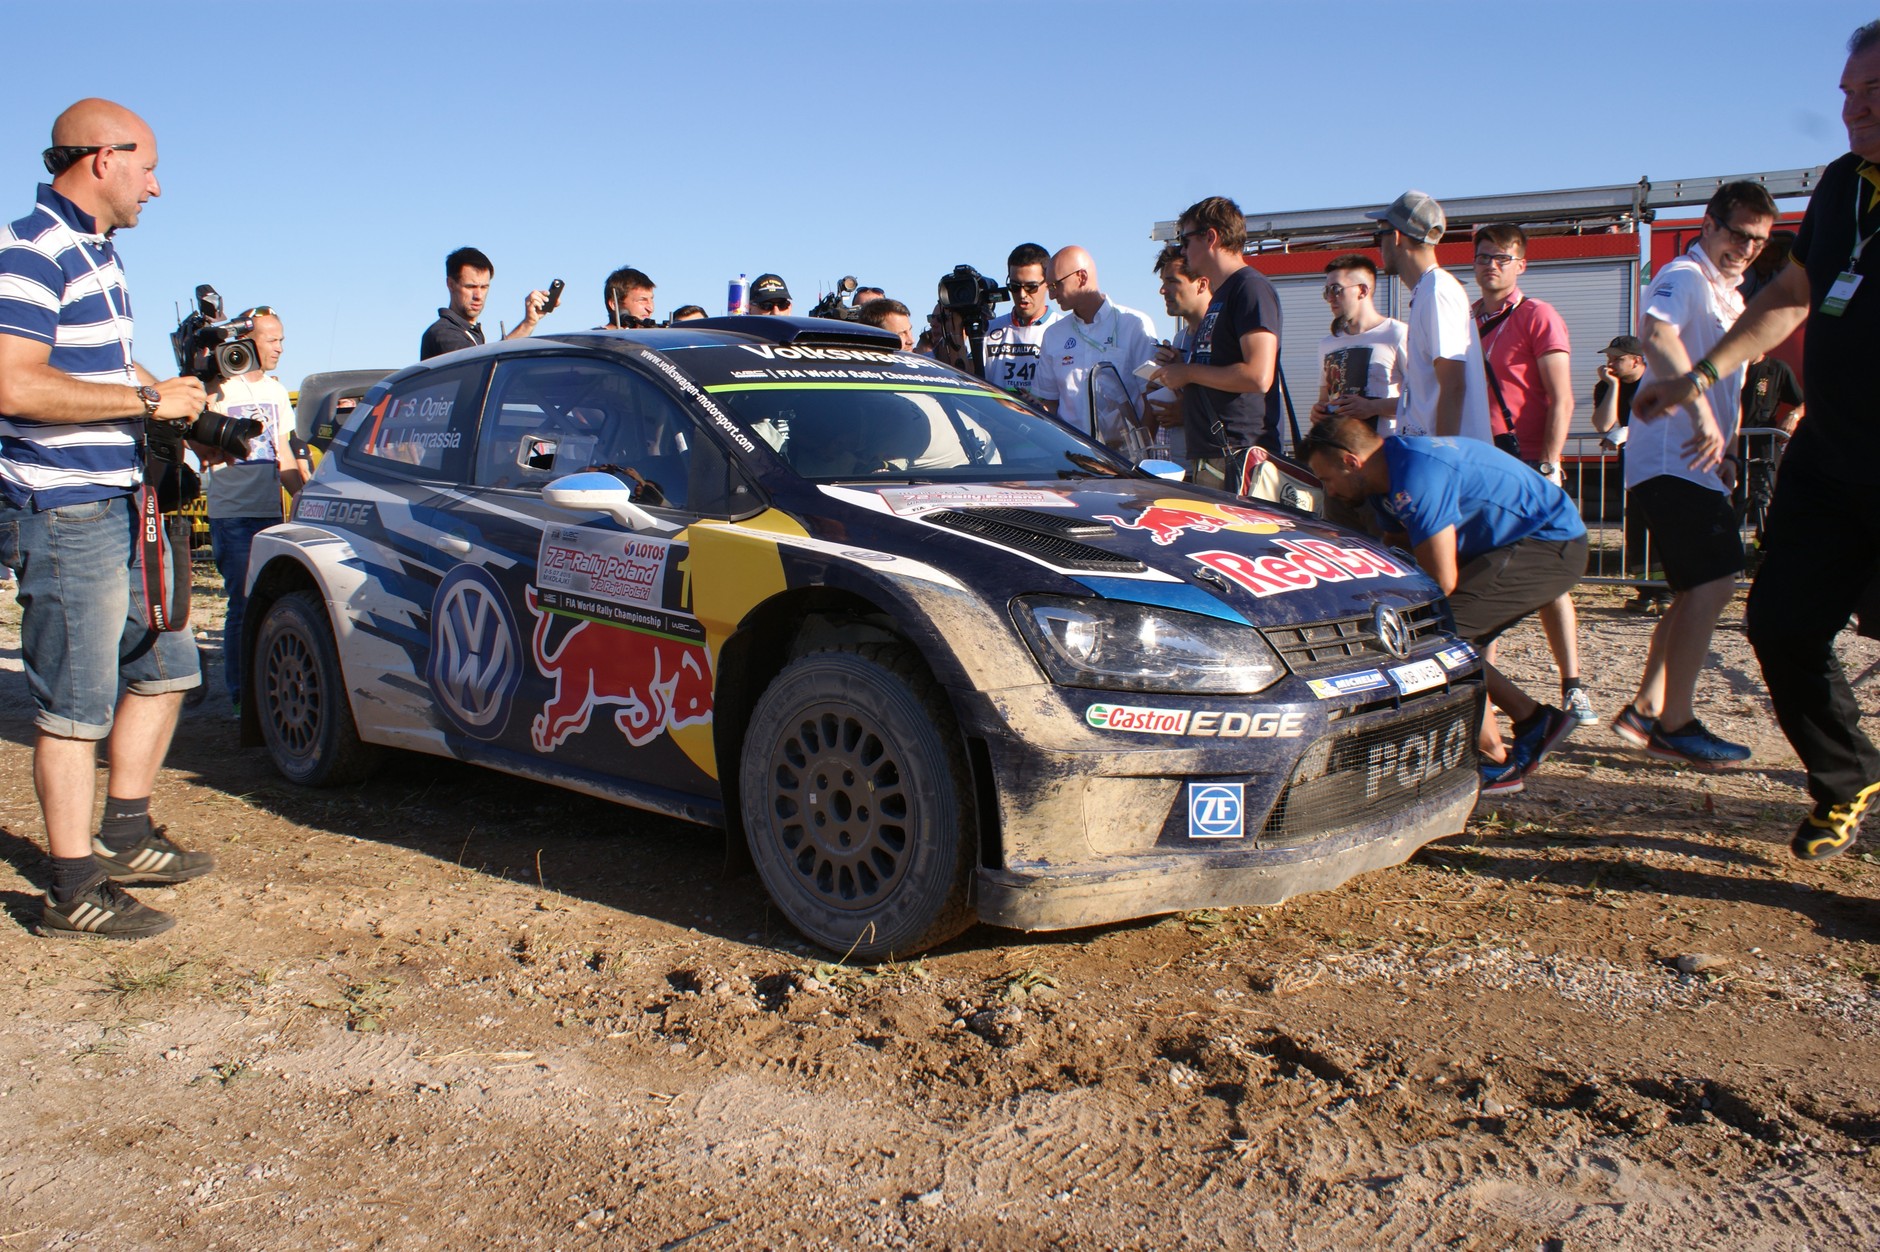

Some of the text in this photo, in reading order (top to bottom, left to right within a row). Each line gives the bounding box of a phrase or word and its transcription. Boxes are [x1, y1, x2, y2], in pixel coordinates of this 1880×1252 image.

[738, 345, 944, 369] Volkswagen
[776, 369, 806, 378] FIA
[803, 370, 848, 378] World
[848, 370, 882, 380] Rally
[1004, 362, 1036, 381] 341
[420, 397, 454, 421] Ogier
[641, 349, 755, 453] www.volkswagen-motorsport.com
[370, 394, 392, 455] 1
[408, 427, 462, 448] Ingrassia
[326, 501, 374, 526] EDGE
[147, 517, 157, 542] EOS
[636, 544, 666, 561] LOTOS
[570, 551, 607, 580] Rally
[604, 556, 659, 586] Poland
[590, 579, 603, 592] 72
[623, 586, 651, 600] Polski
[565, 598, 577, 609] FIA
[577, 600, 595, 613] World
[596, 604, 613, 617] Rally
[613, 607, 662, 628] Championship
[1335, 673, 1384, 690] MICHELIN
[1109, 707, 1307, 737] Castrol EDGE
[1366, 719, 1466, 800] POLO
[1197, 796, 1240, 826] ZF
